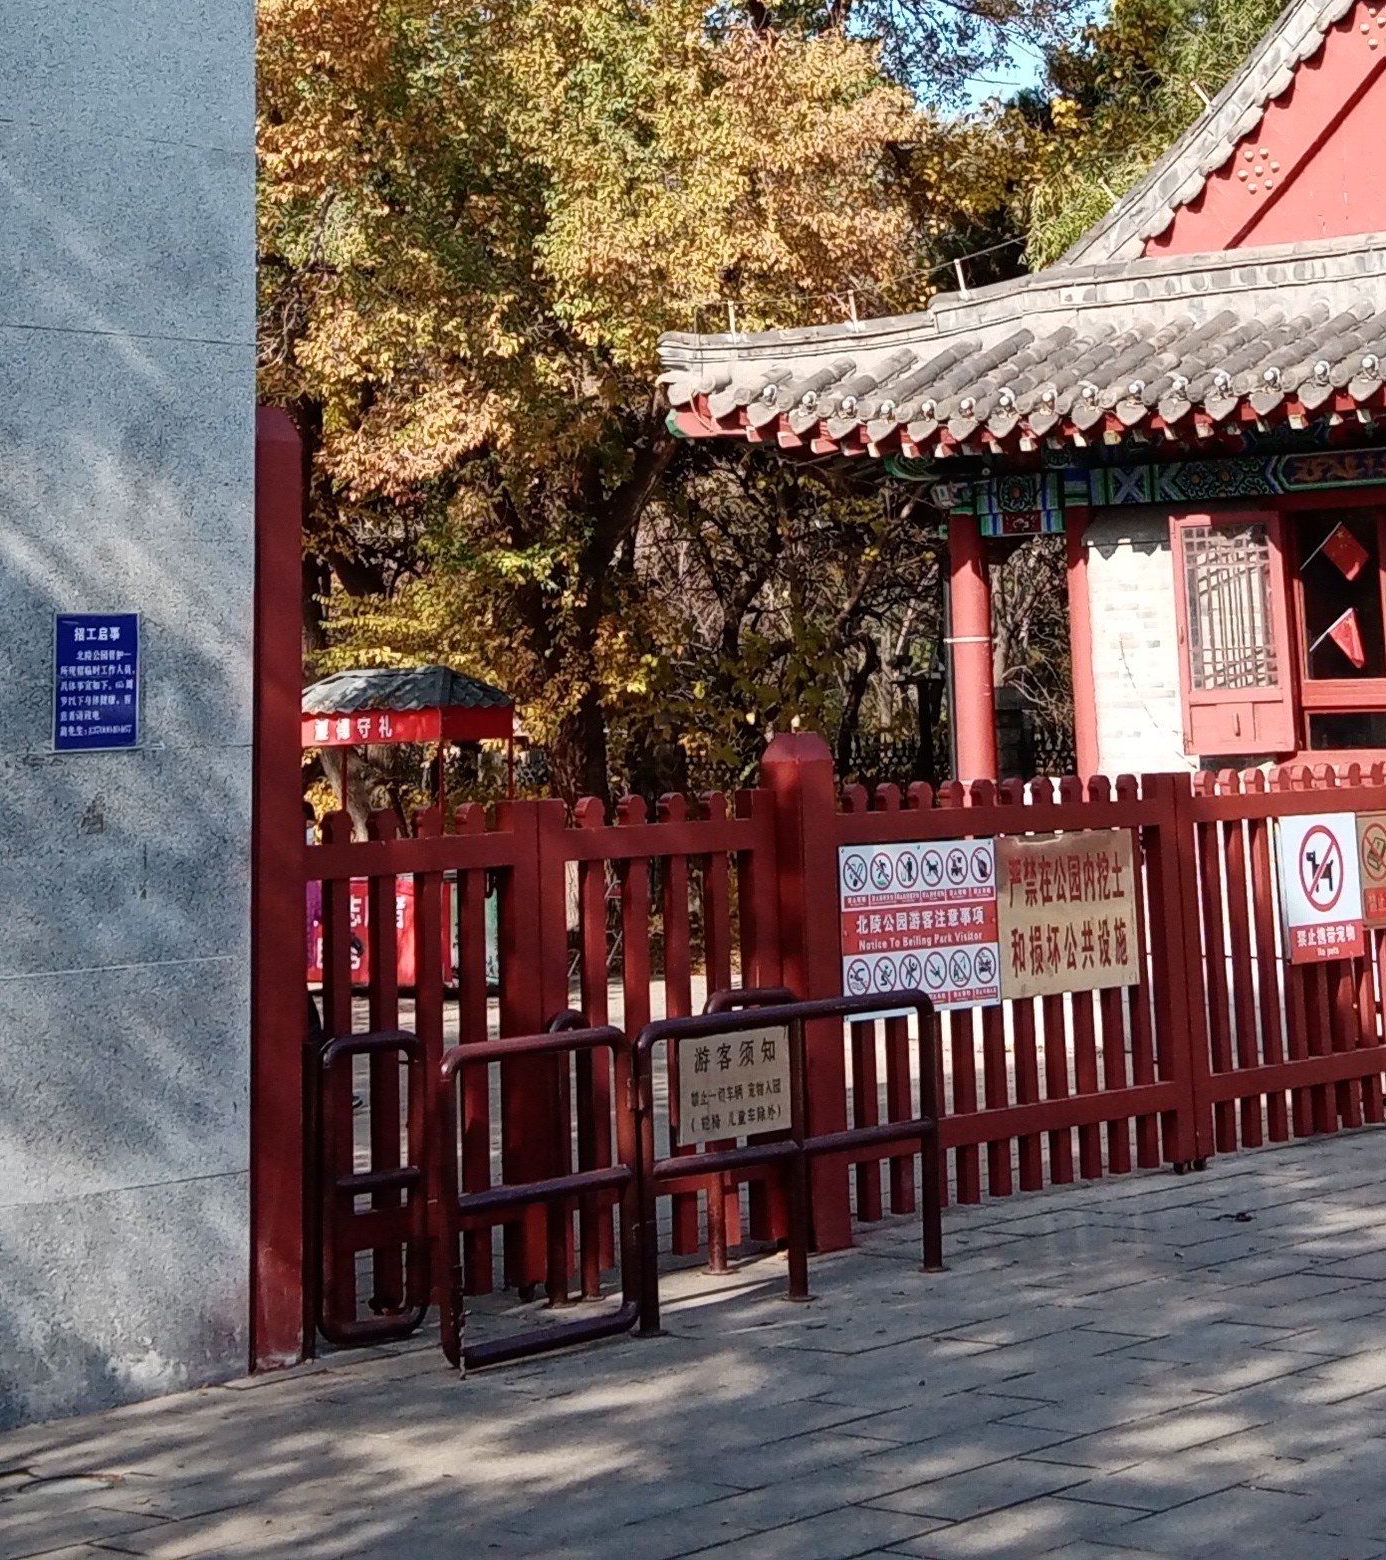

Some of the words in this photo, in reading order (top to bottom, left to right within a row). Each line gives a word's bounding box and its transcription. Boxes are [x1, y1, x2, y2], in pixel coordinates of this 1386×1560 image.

[74, 626, 121, 642] 招工启事
[1008, 851, 1125, 907] 严禁在公园内挖土
[856, 906, 985, 935] 北陵公园游客注意事项
[859, 938, 887, 951] Notice
[889, 937, 900, 948] To
[934, 933, 953, 944] Park
[955, 931, 983, 942] Visitor
[1011, 921, 1129, 977] 和损坏公共设施
[1297, 924, 1356, 947] 禁止携带宠物
[694, 1037, 776, 1074] 游客须知
